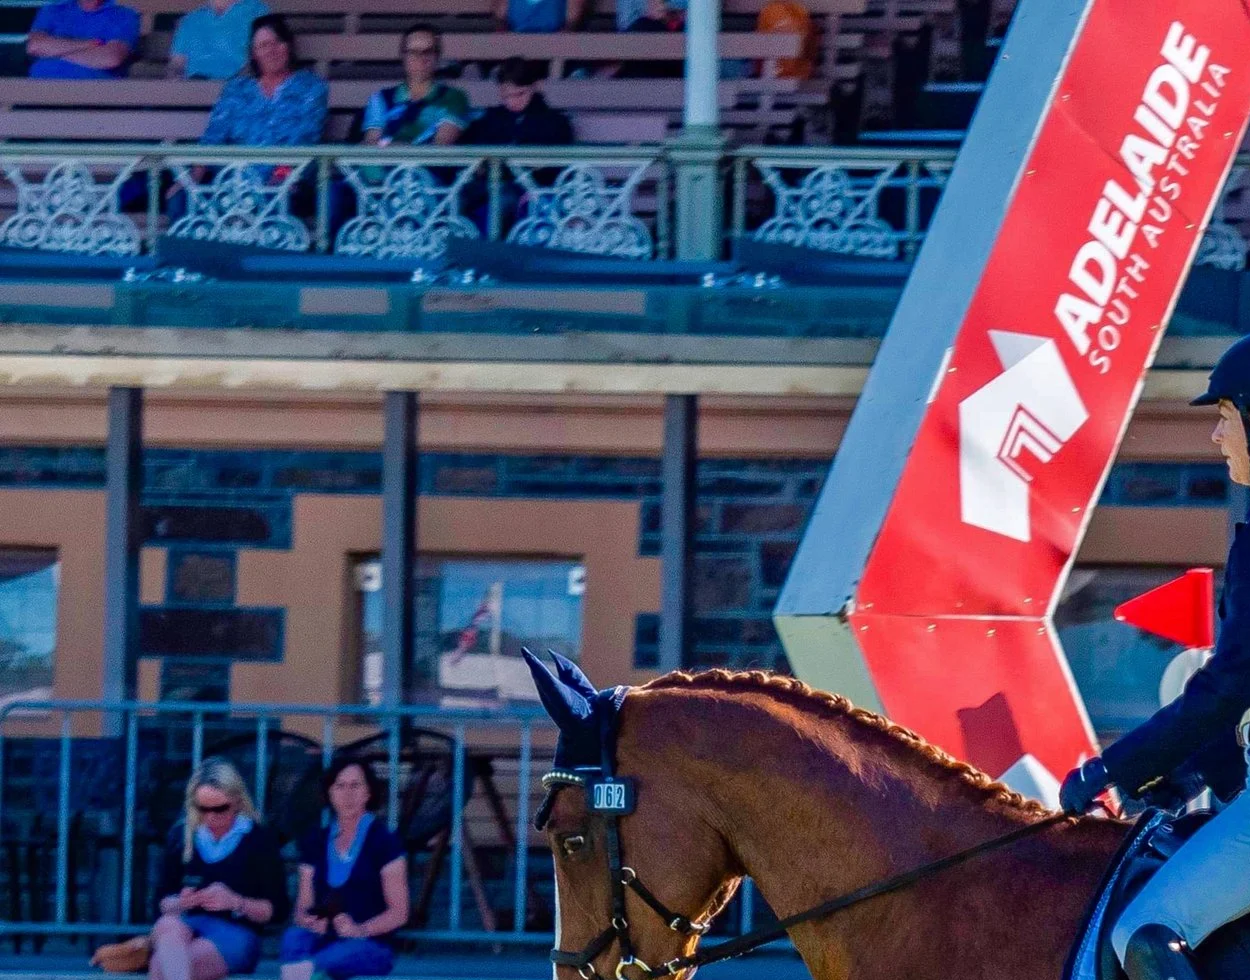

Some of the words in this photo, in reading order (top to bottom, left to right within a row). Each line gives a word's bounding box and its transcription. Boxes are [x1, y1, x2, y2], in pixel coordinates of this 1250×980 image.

[1054, 21, 1211, 356] ADELAIDE
[1089, 253, 1150, 375] SOUTH
[1142, 63, 1232, 249] AUSTRALIA
[595, 785, 623, 808] 062
